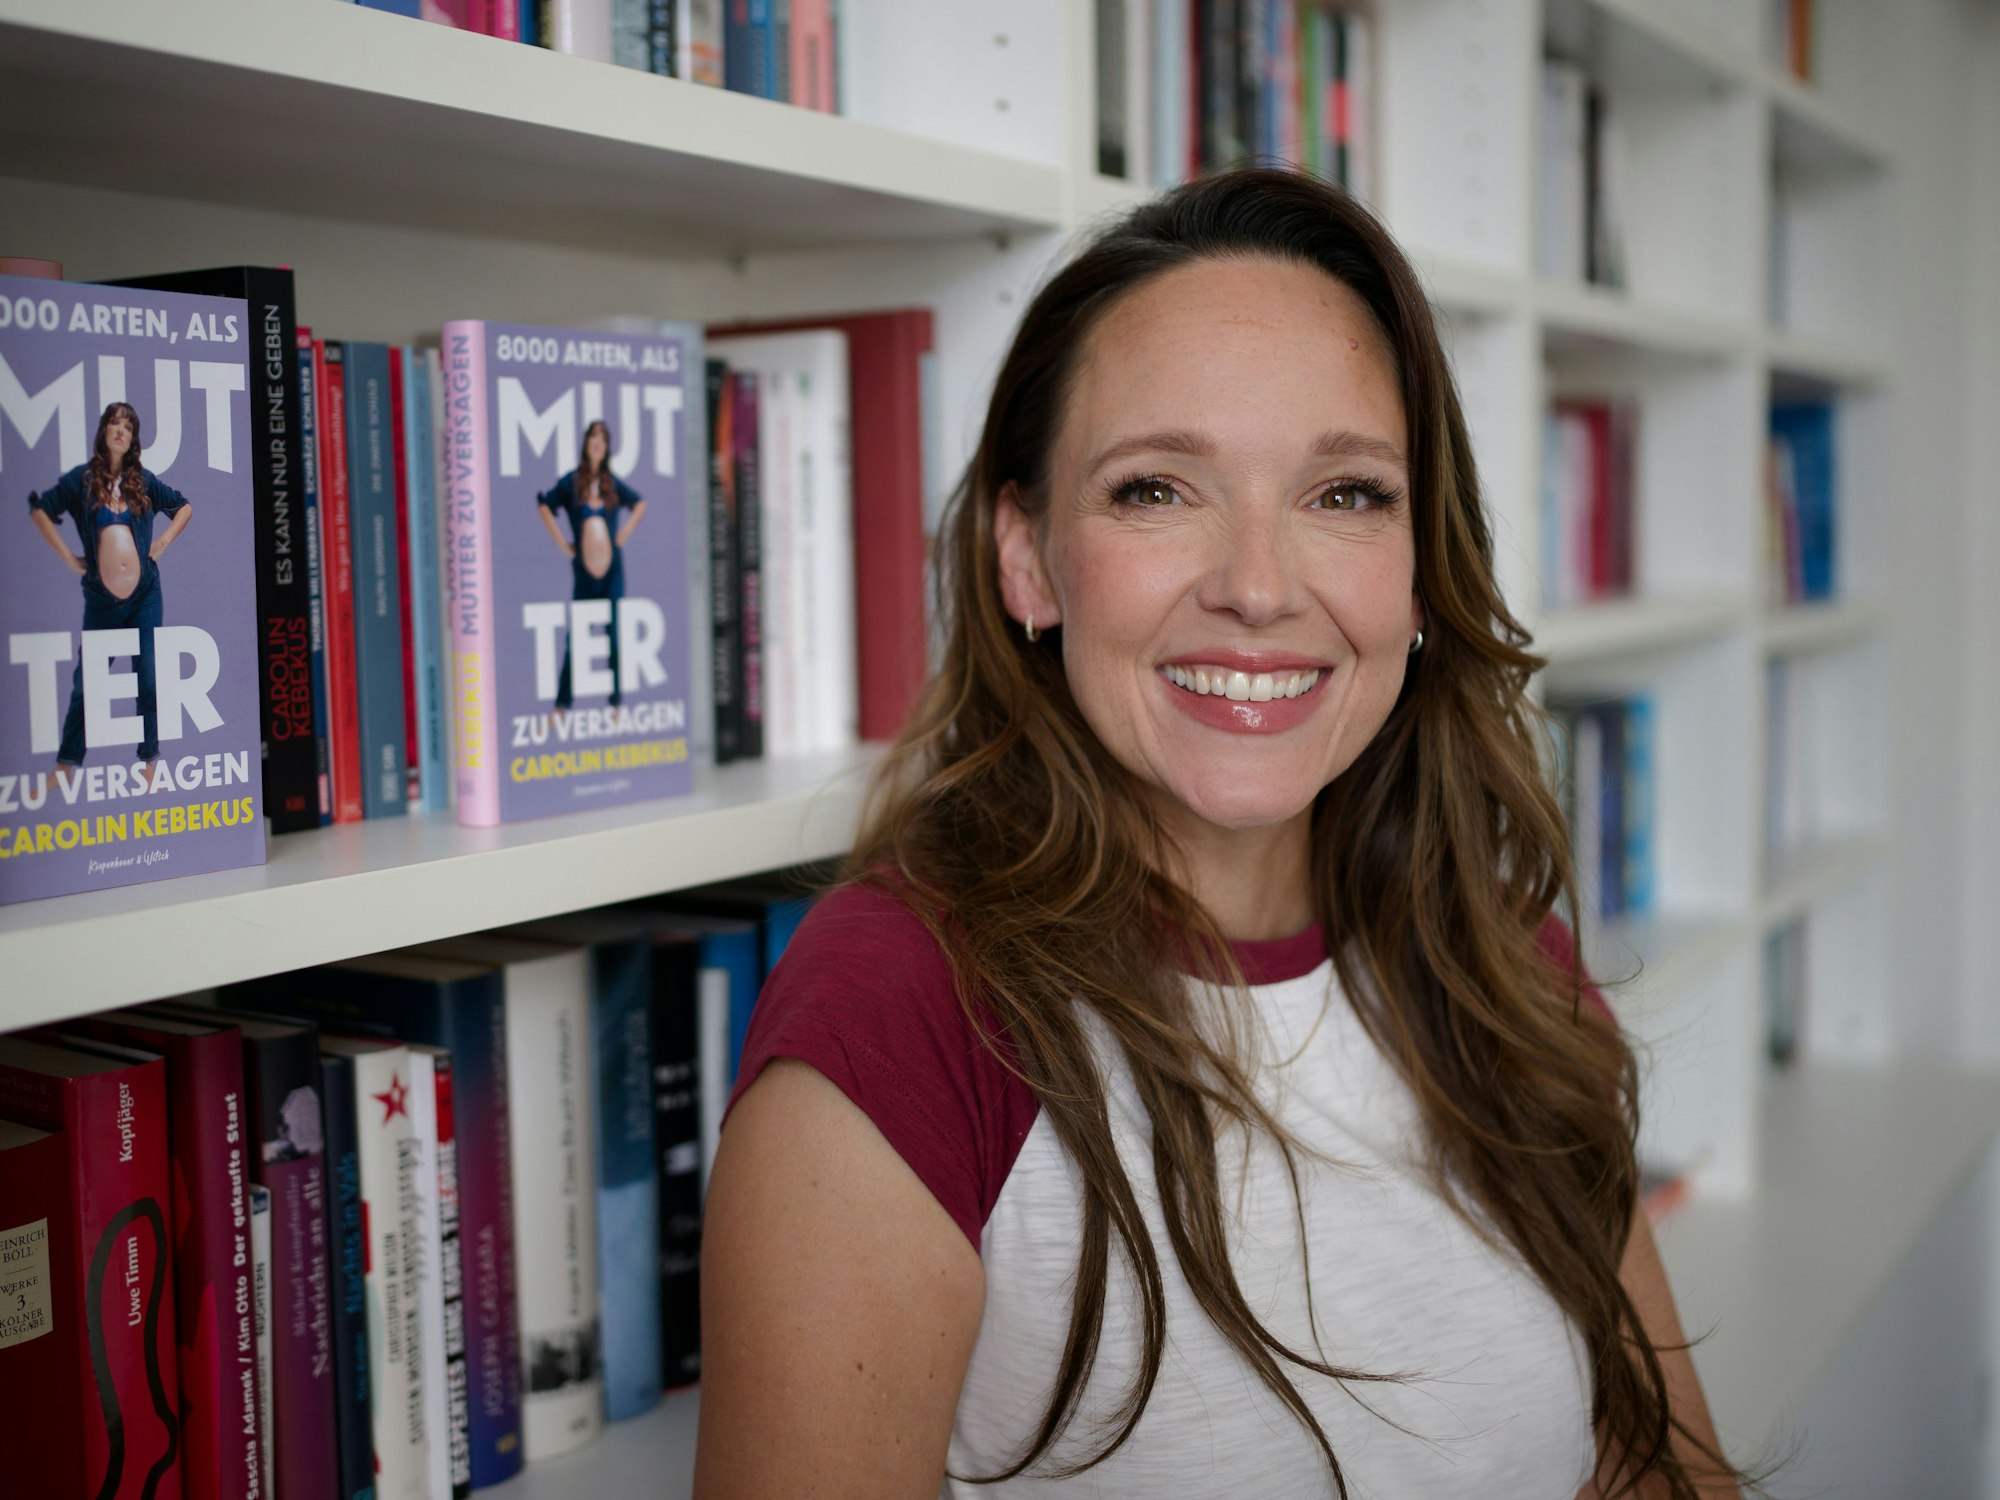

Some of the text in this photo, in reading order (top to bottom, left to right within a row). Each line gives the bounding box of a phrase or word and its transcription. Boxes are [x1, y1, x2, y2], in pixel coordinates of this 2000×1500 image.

[0, 294, 239, 344] 000 ARTEN, ALS
[497, 334, 679, 373] 8000 ARTEN, ALS
[0, 350, 246, 476] MUT
[451, 335, 474, 481] VERSAGEN
[498, 376, 683, 479] MUT
[264, 304, 293, 585] ES KANN NUR EINE GEBEN
[457, 490, 476, 523] ZU
[459, 534, 479, 635] MUTTER
[268, 618, 292, 741] CAROLIN
[287, 616, 311, 738] KEBEKUS
[523, 597, 667, 700] TER
[9, 625, 225, 754] TER
[463, 652, 483, 768] KEBEKUS
[512, 701, 684, 747] ZU VERSAGEN
[0, 751, 249, 813] ZU VERSAGEN
[511, 737, 688, 782] CAROLIN KEBEKUS
[0, 797, 254, 859] CAROLIN KEBEKUS
[136, 854, 142, 865] &
[143, 849, 170, 867] Witsch
[117, 1082, 136, 1163] Kopfjäger
[224, 1092, 246, 1267] Der gekaufte Staat
[303, 1166, 321, 1210] alle
[0, 1228, 45, 1251] EINRICH
[3, 1247, 33, 1263] BÖLL
[0, 1276, 39, 1294] WERKE
[17, 1294, 26, 1311] 3
[126, 1236, 142, 1327] Uwe Timm
[235, 1275, 249, 1315] Otto
[0, 1308, 43, 1328] KÖLNER
[236, 1316, 251, 1351] Kim
[308, 1255, 329, 1377] Nachricht
[240, 1368, 256, 1435] Adamek
[243, 1440, 259, 1500] Sascha
